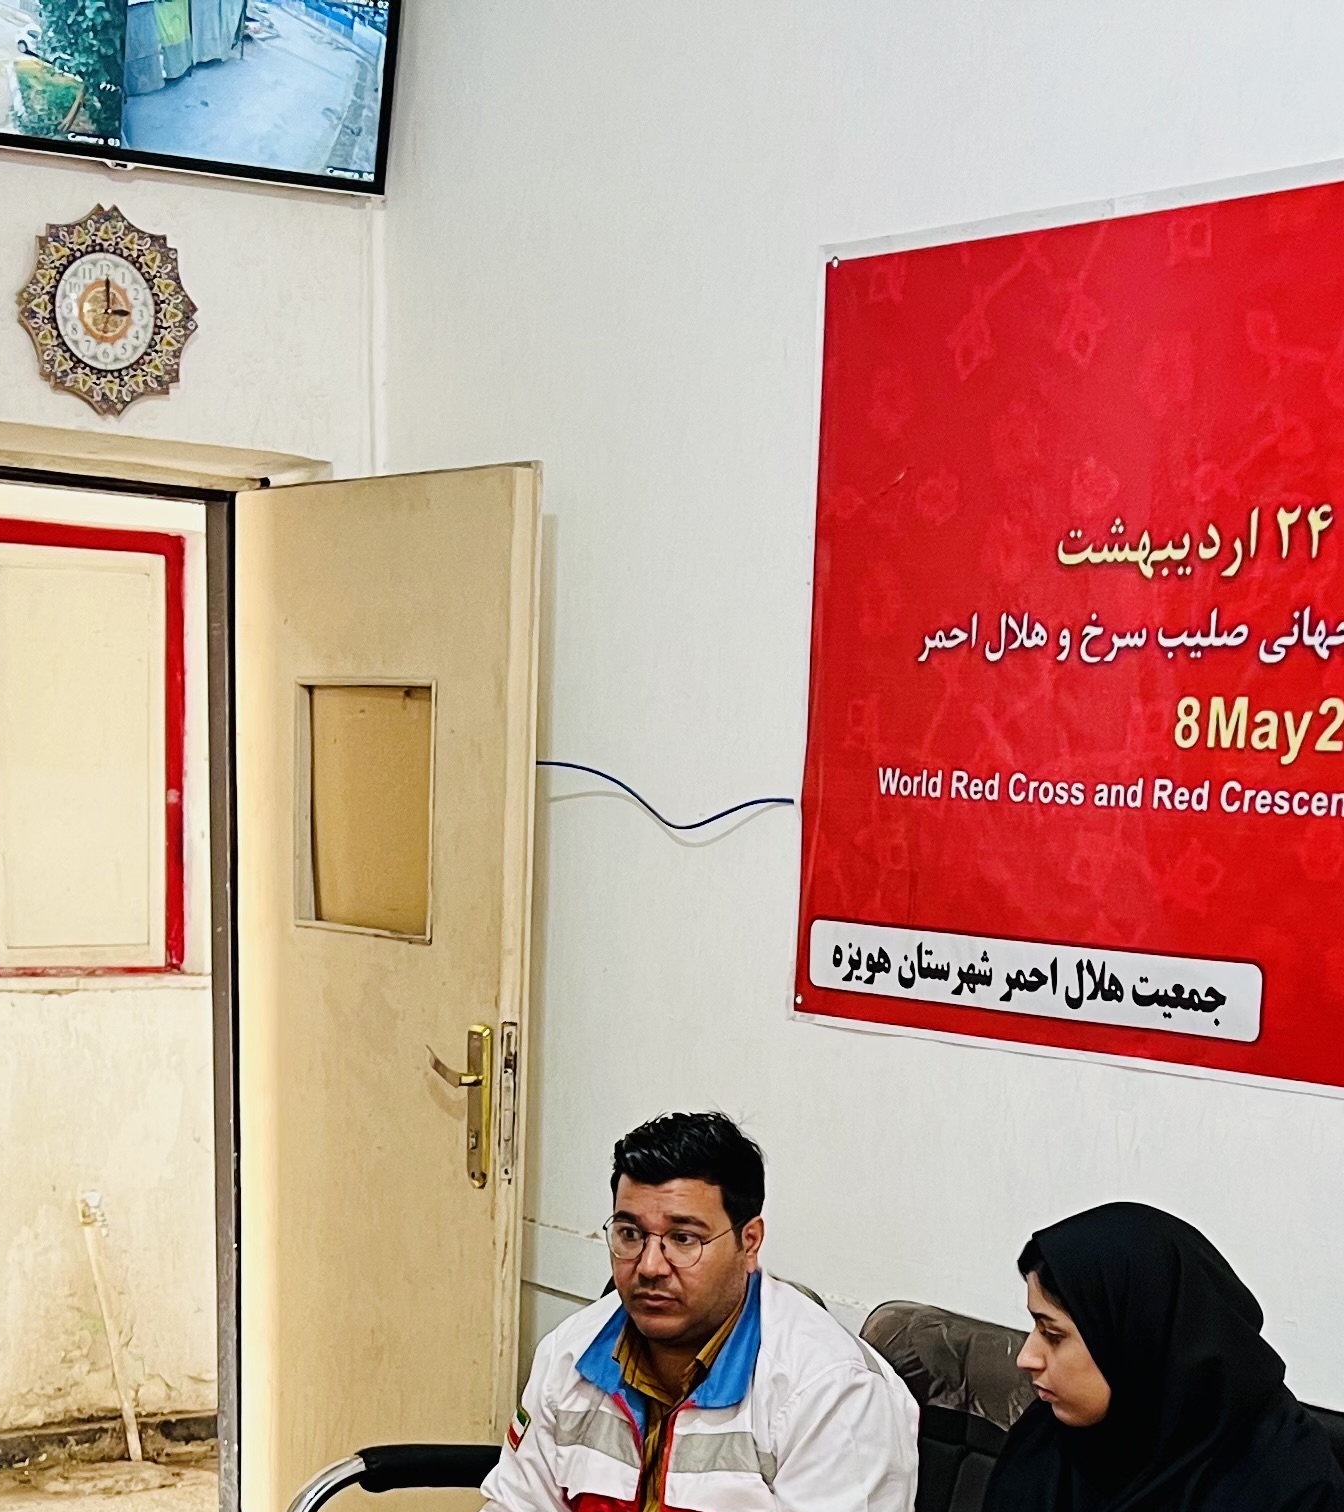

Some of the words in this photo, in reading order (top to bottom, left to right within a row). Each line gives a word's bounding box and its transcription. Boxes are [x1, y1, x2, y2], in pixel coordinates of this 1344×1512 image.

[1057, 507, 1259, 579] اردیبهشت
[1276, 504, 1333, 559] ۲۴
[917, 612, 978, 662] احمر
[984, 612, 1048, 662] هلال
[1056, 628, 1071, 661] و
[1079, 612, 1147, 663] سرخ
[1157, 608, 1249, 659] صلیب
[878, 767, 943, 798] World
[950, 770, 1000, 801] Red
[1008, 772, 1085, 806] Cross
[1093, 777, 1144, 808] and
[1152, 778, 1210, 812] Red
[832, 941, 892, 984] هویزه
[999, 956, 1058, 1002] احمر
[1065, 959, 1124, 1010] هلال
[1132, 976, 1227, 1026] جمعیت
